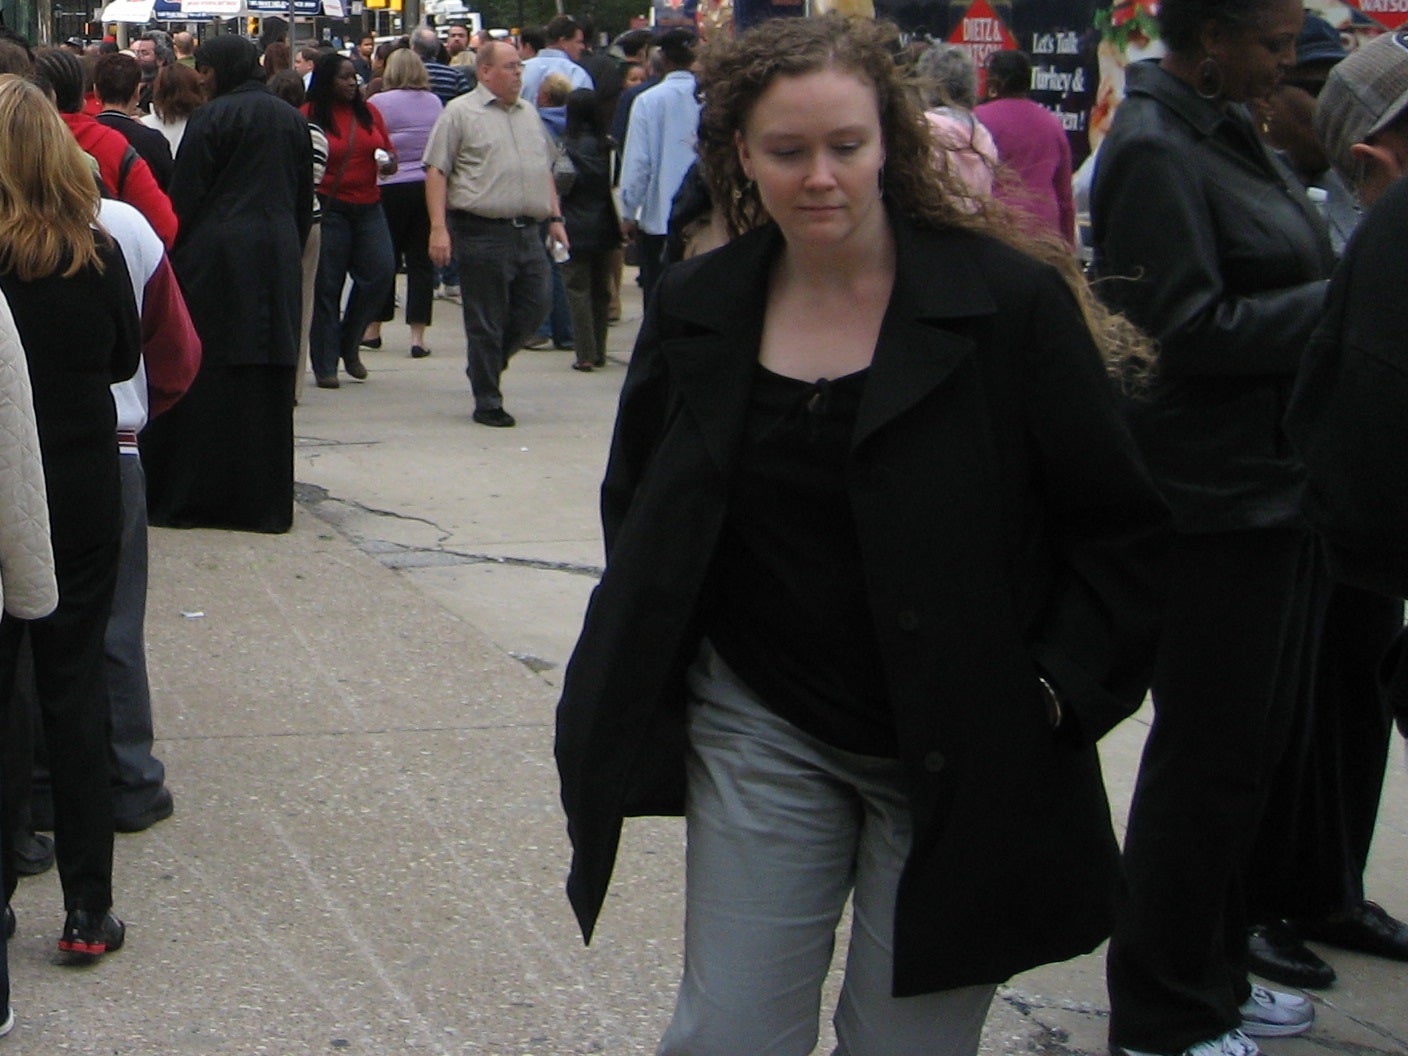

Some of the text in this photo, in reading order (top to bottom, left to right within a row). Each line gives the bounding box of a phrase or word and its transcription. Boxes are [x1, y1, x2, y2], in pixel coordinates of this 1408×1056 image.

[963, 17, 992, 41] DIETZ
[993, 20, 1002, 41] &
[1055, 31, 1079, 54] Talk
[1031, 64, 1085, 99] Turkey &
